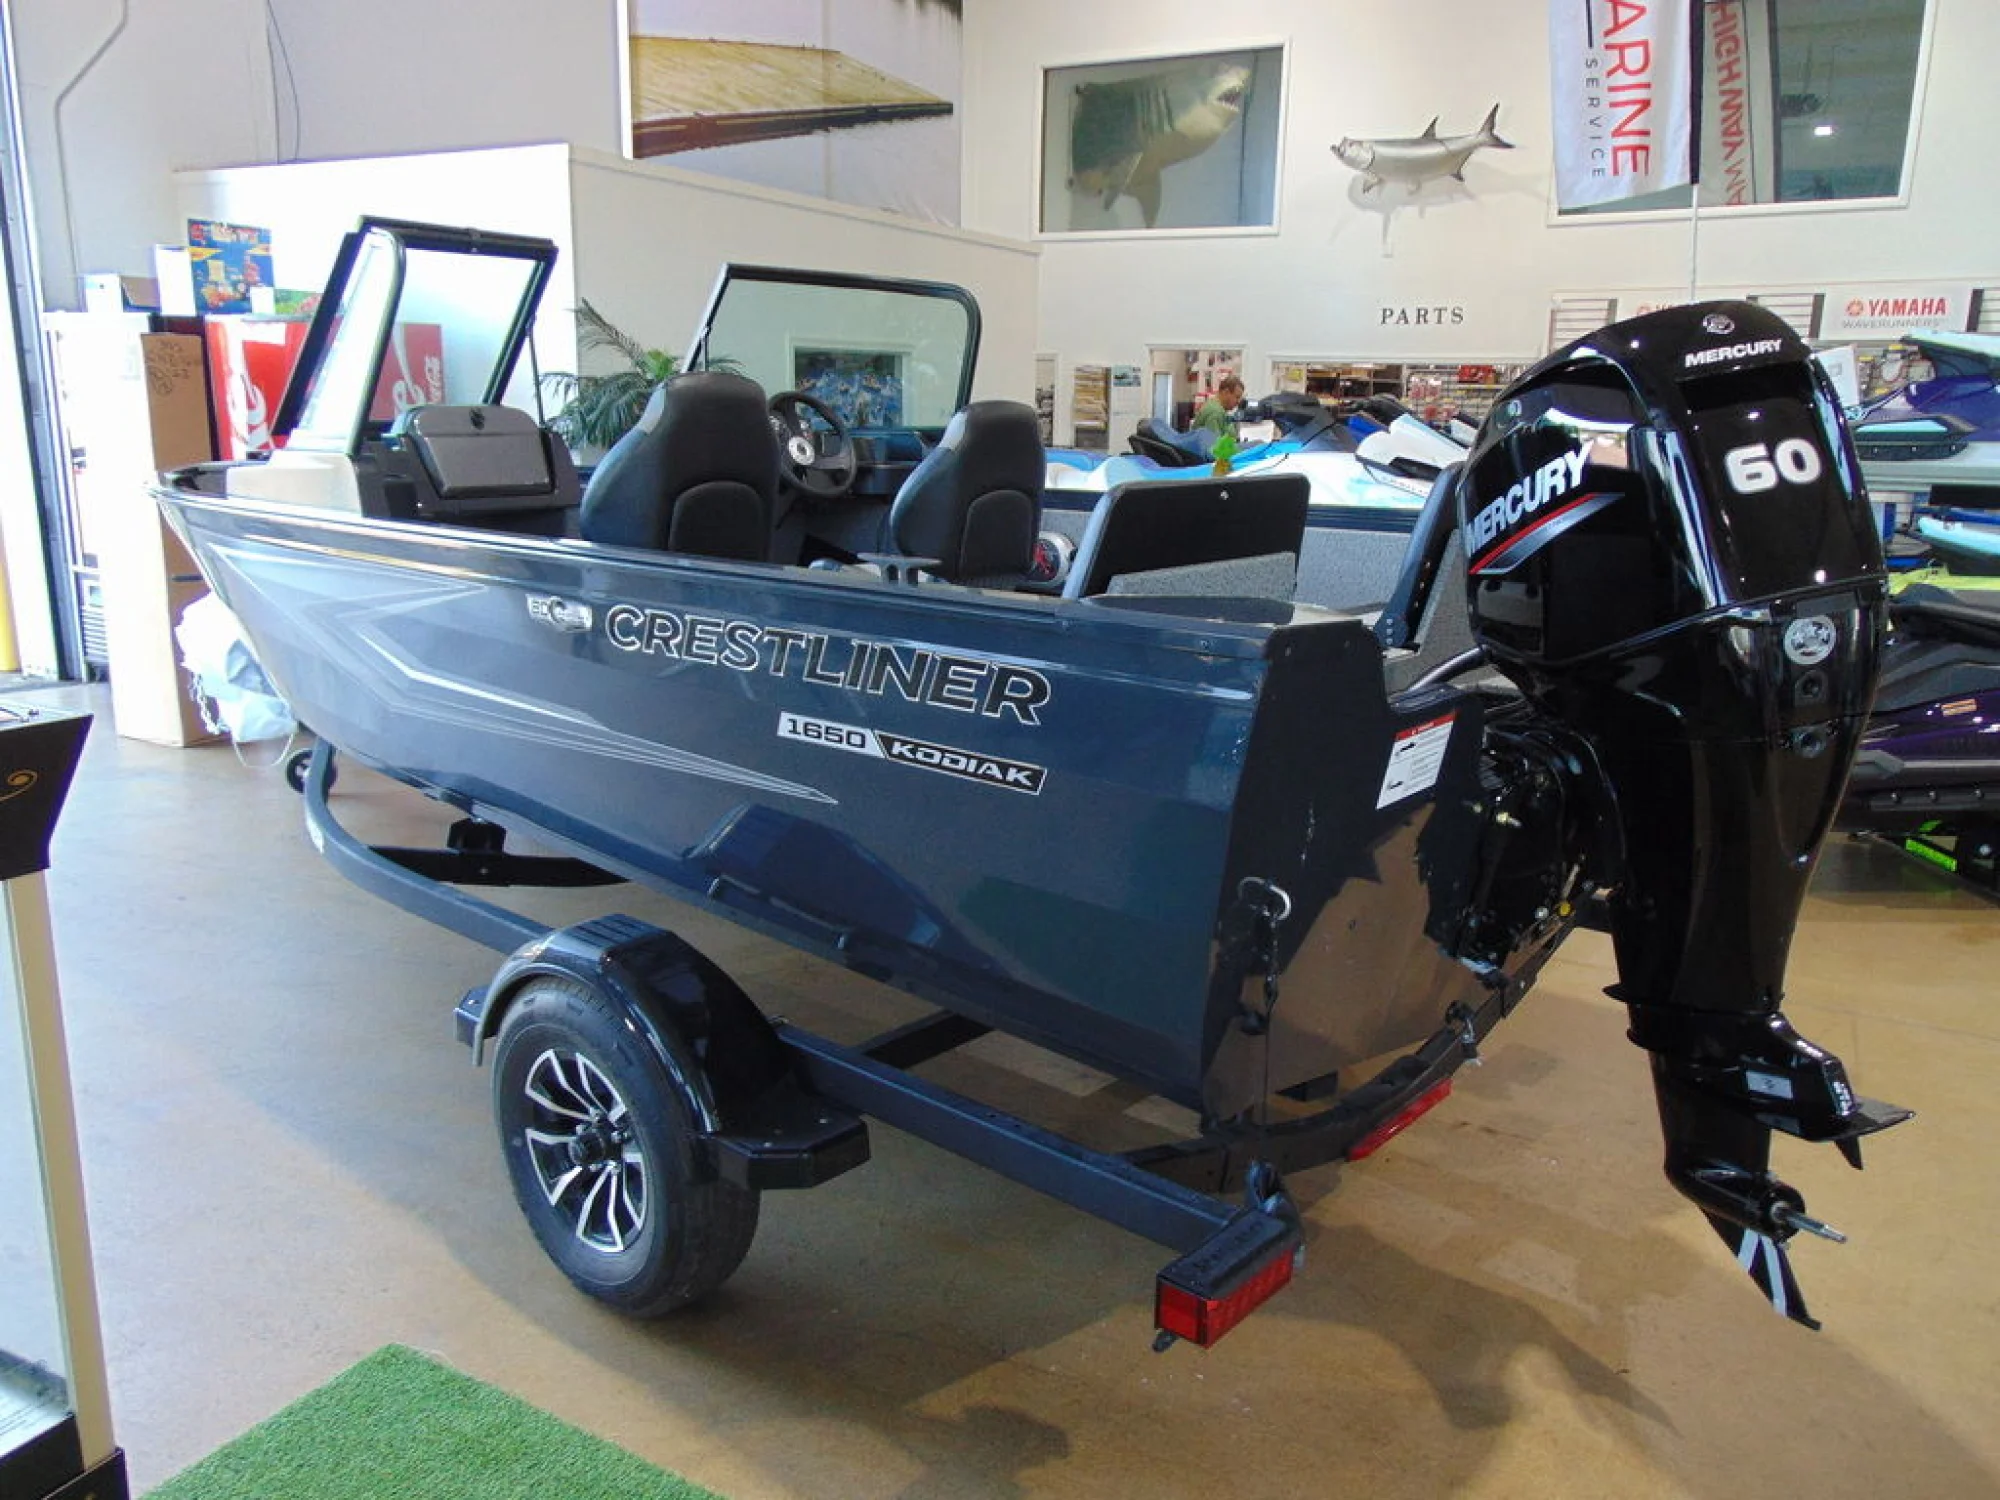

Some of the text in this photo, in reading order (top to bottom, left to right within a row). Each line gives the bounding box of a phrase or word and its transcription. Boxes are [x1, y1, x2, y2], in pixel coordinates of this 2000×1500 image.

[1585, 58, 1605, 178] SERVICE
[1380, 306, 1464, 325] PARTS
[1868, 297, 1946, 316] YAMAHA
[1685, 338, 1782, 367] MERCURY
[1724, 438, 1820, 494] 60
[1466, 439, 1594, 558] MERCURY
[605, 604, 1050, 726] CRESTLINER
[788, 718, 1034, 786] 1650 KODIAK
